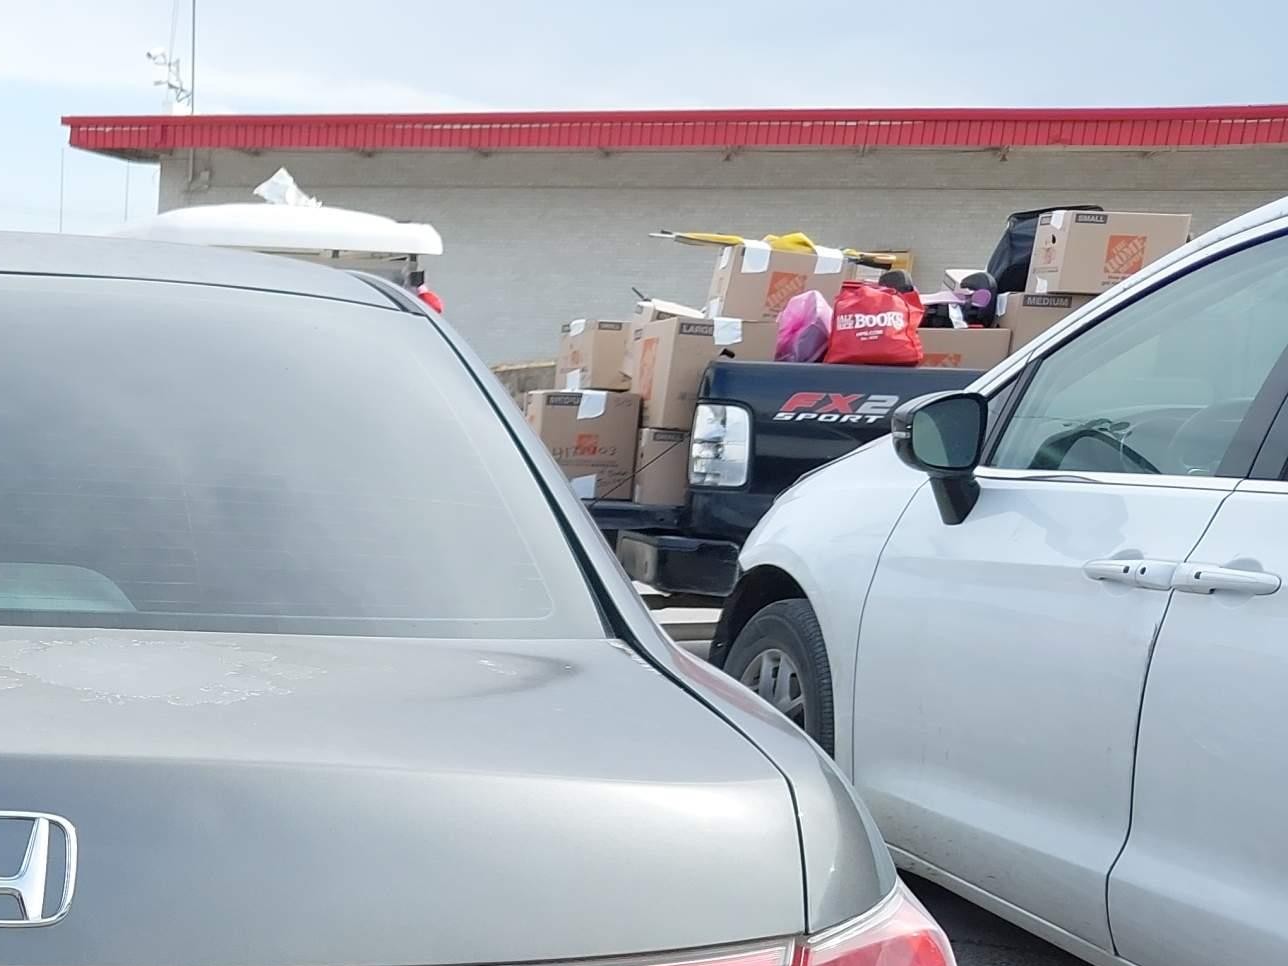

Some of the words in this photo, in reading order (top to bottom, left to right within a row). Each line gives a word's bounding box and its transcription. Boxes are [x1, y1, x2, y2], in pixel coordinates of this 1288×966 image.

[1078, 214, 1105, 223] SMALL
[1027, 296, 1069, 306] MEDIUM
[854, 311, 905, 331] BOOKS
[778, 391, 900, 415] FX2
[772, 412, 885, 424] SPORT
